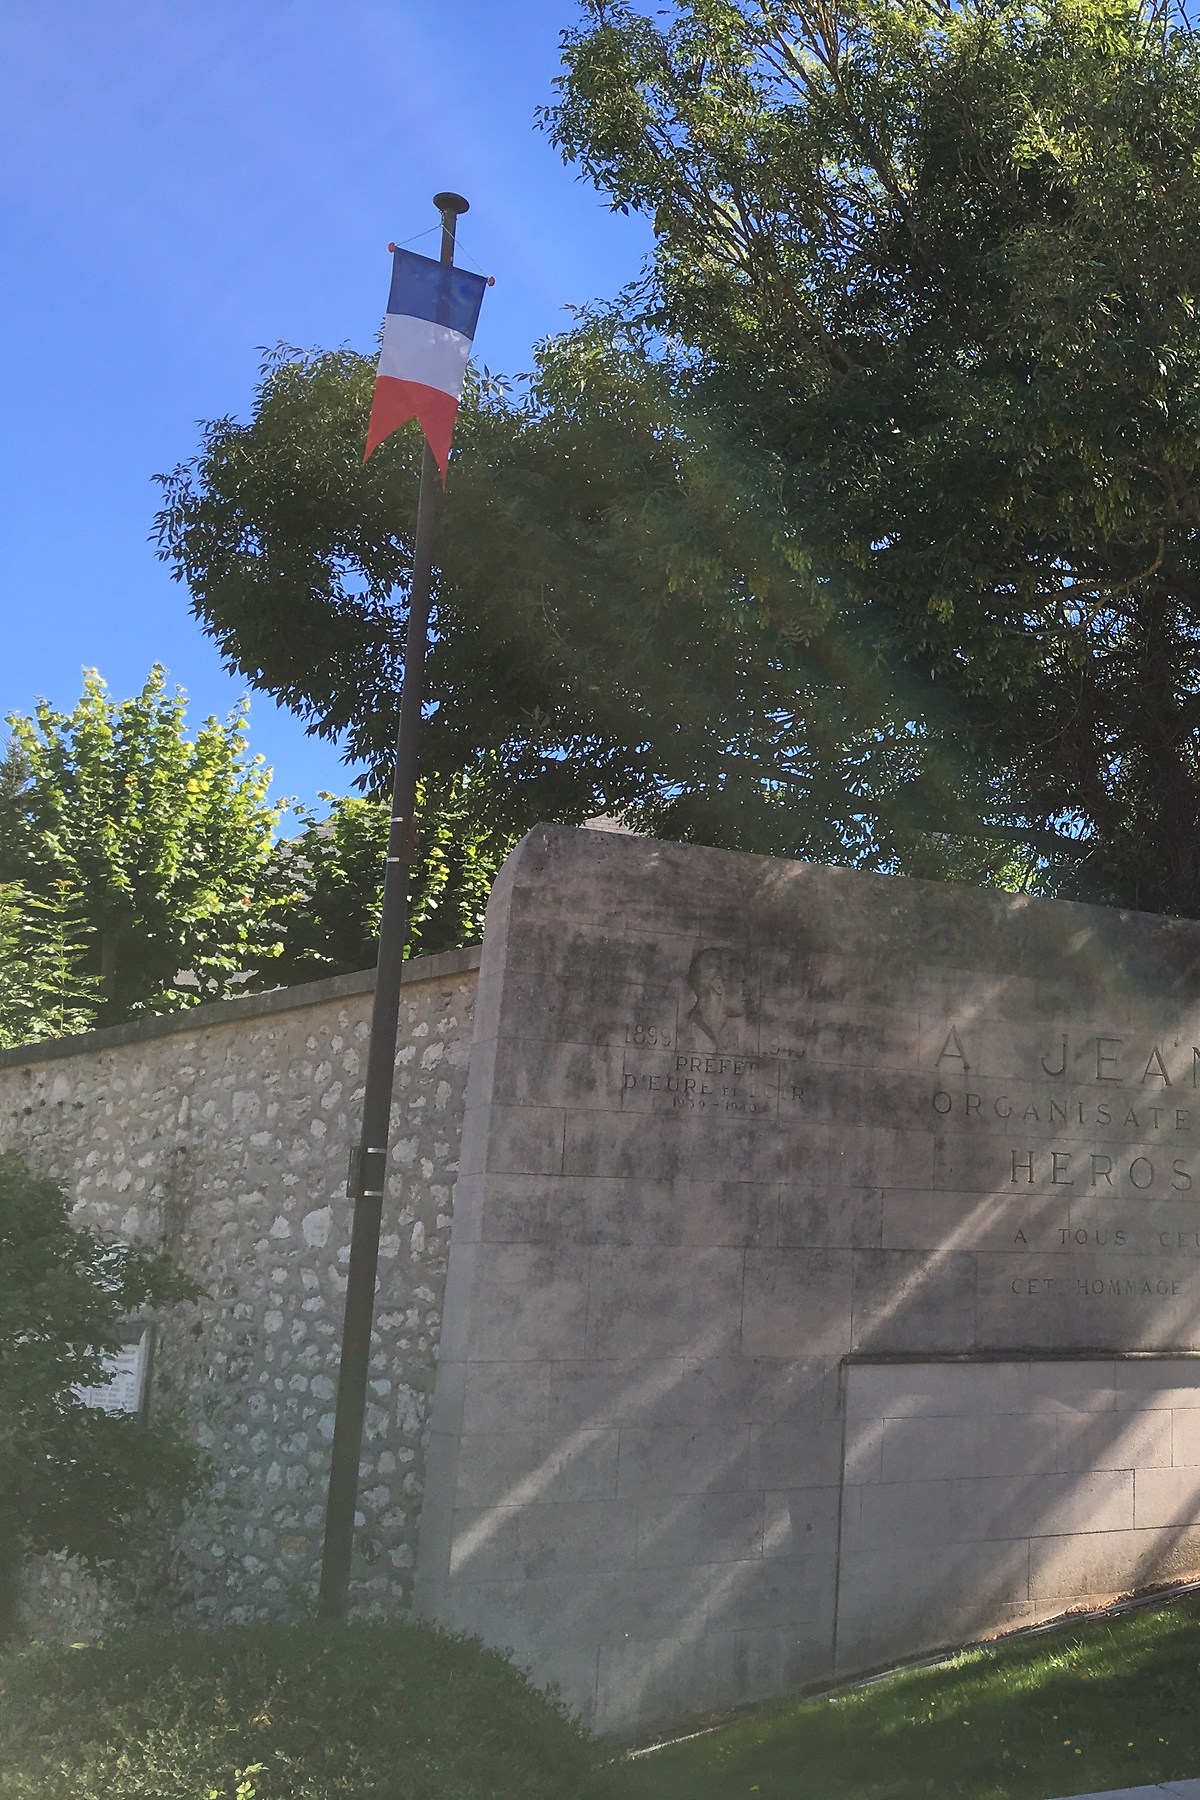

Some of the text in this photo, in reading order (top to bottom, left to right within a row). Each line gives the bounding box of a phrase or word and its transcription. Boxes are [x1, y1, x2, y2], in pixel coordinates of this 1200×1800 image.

[625, 1023, 671, 1047] 1899
[934, 1024, 972, 1072] A
[675, 1055, 758, 1077] PREFET
[1010, 1150, 1193, 1192] HEROS
[1013, 1229, 1029, 1244] A
[1058, 1228, 1127, 1246] TOUS
[1011, 1279, 1054, 1295] CET
[1077, 1279, 1182, 1296] HOMMAGE
